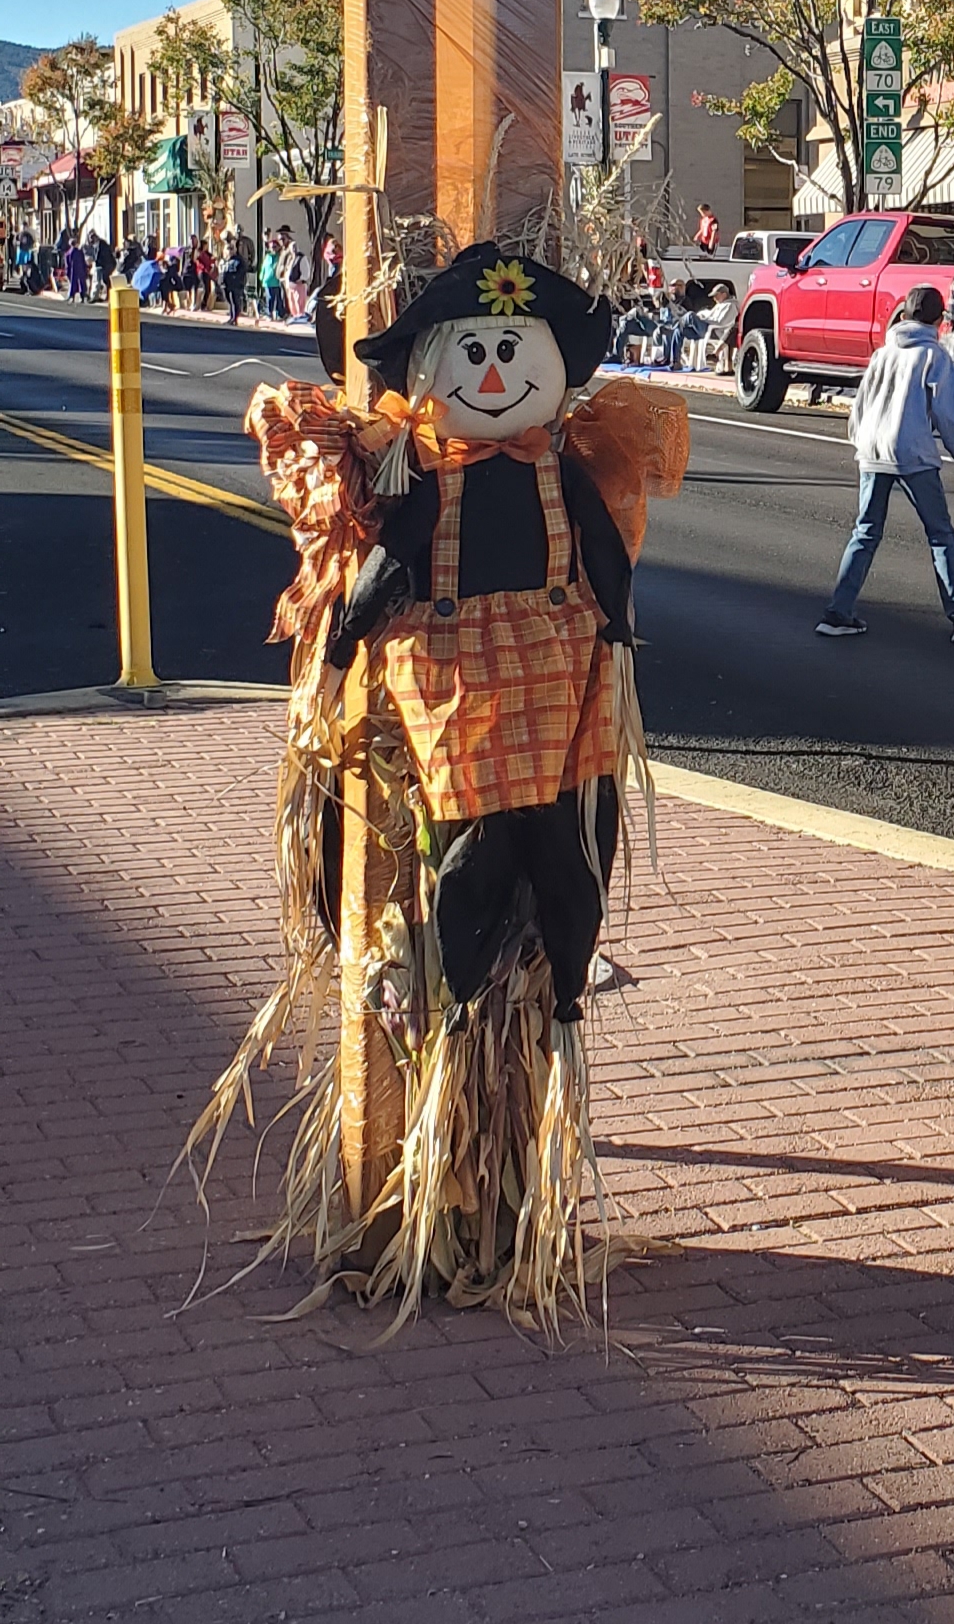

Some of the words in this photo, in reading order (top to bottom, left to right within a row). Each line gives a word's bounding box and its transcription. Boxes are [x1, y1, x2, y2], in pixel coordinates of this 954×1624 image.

[871, 21, 895, 35] EAST
[873, 73, 894, 89] 70
[614, 130, 648, 143] UT
[870, 124, 897, 139] END
[223, 148, 248, 156] UTAH
[873, 176, 894, 192] 79
